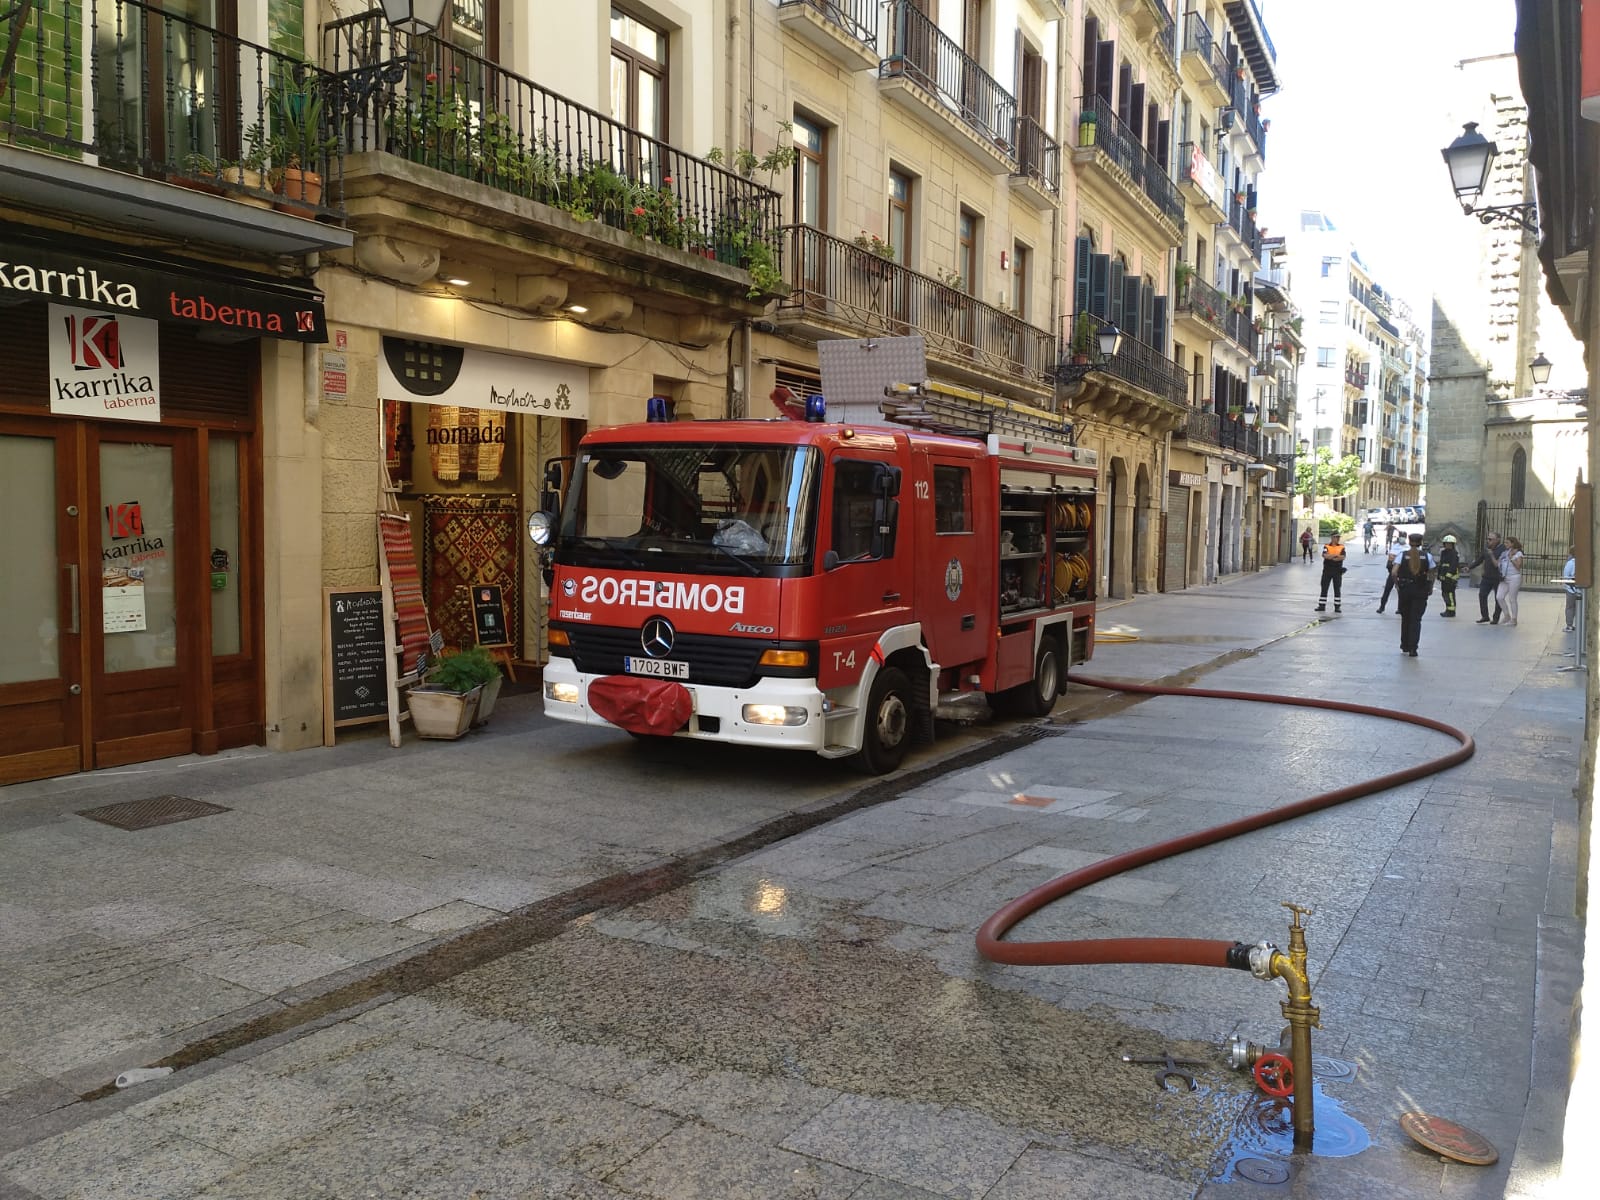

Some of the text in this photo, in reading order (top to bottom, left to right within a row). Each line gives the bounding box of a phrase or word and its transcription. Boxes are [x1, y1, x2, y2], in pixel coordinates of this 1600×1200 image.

[169, 292, 283, 332] taberna
[55, 374, 154, 399] karrika
[104, 395, 156, 409] taberna
[426, 420, 505, 444] nomada
[915, 480, 929, 499] 112
[102, 537, 164, 560] karrika
[633, 659, 686, 676] 1702 BWF
[833, 649, 856, 671] T-4
